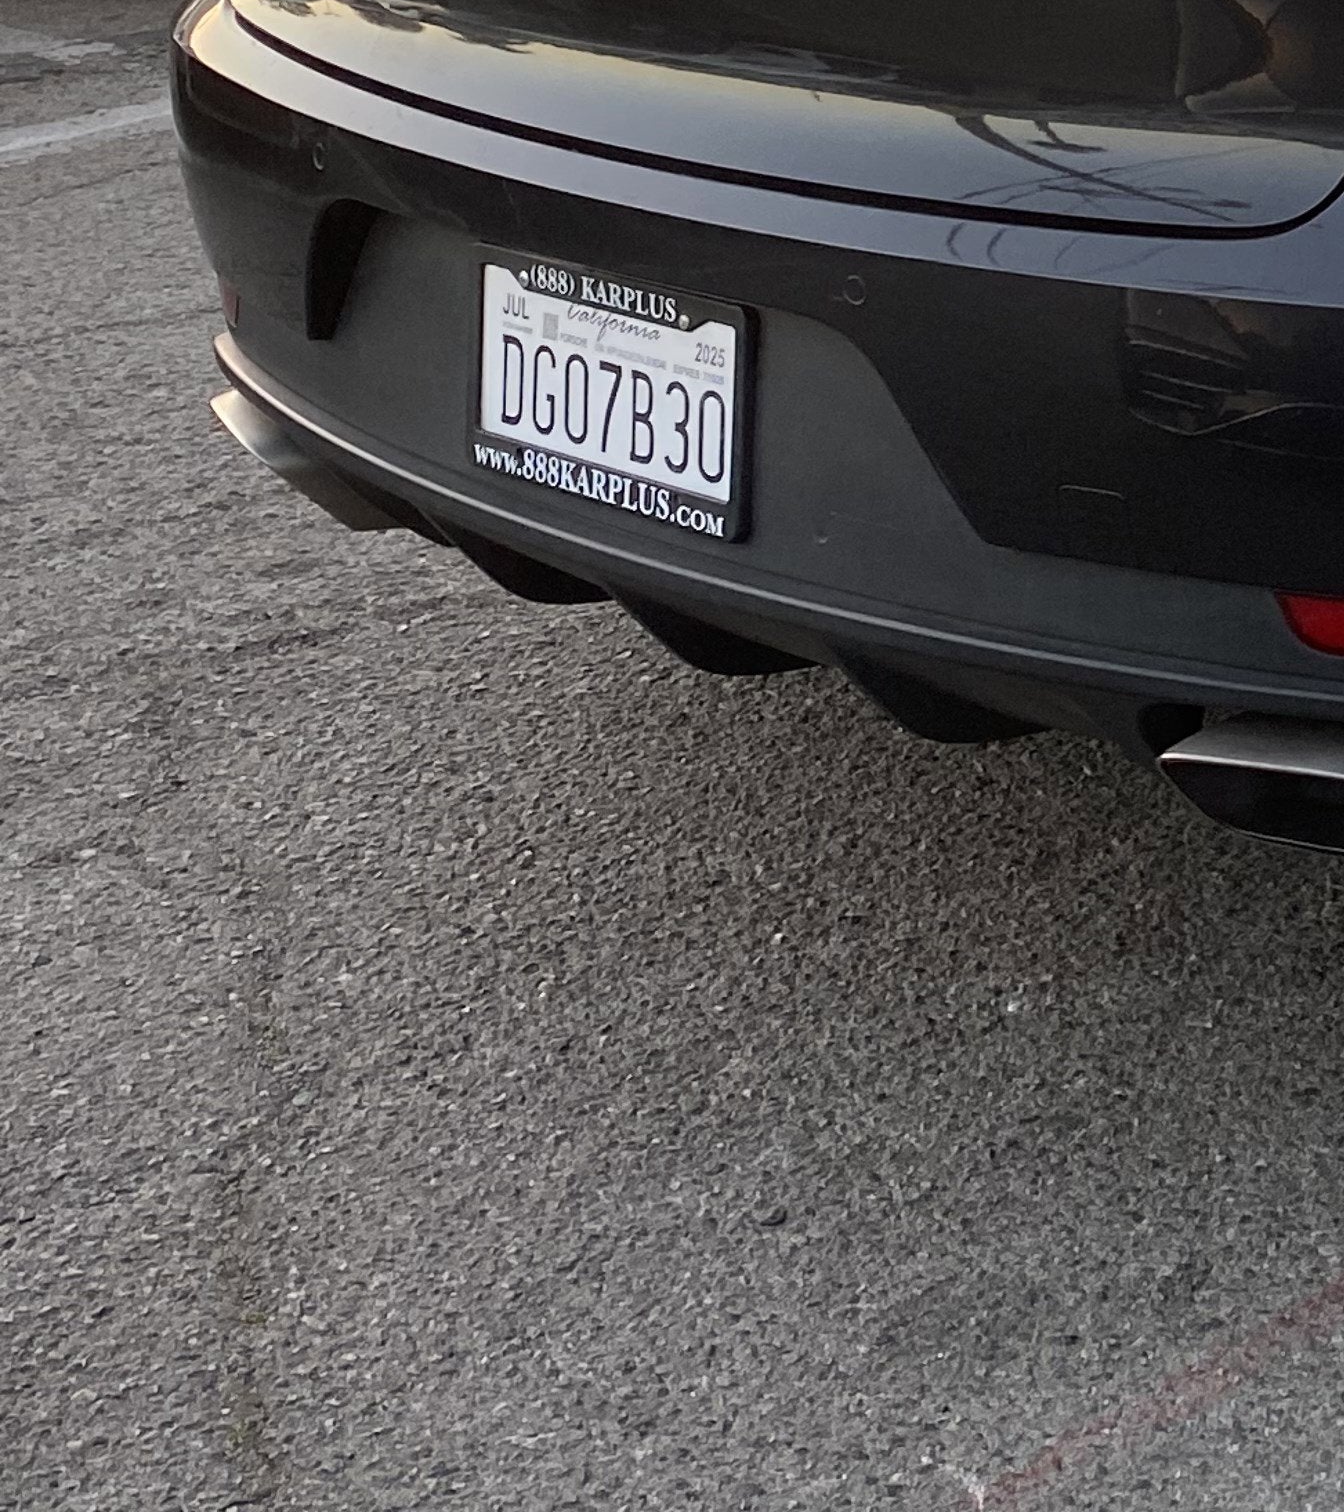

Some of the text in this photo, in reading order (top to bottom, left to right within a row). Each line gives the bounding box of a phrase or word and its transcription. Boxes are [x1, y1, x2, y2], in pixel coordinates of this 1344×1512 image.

[502, 293, 530, 320] JUL
[529, 264, 677, 323] (888) KARPLUS
[566, 303, 662, 341] California
[694, 342, 726, 369] 2025
[500, 334, 726, 484] DG07B30
